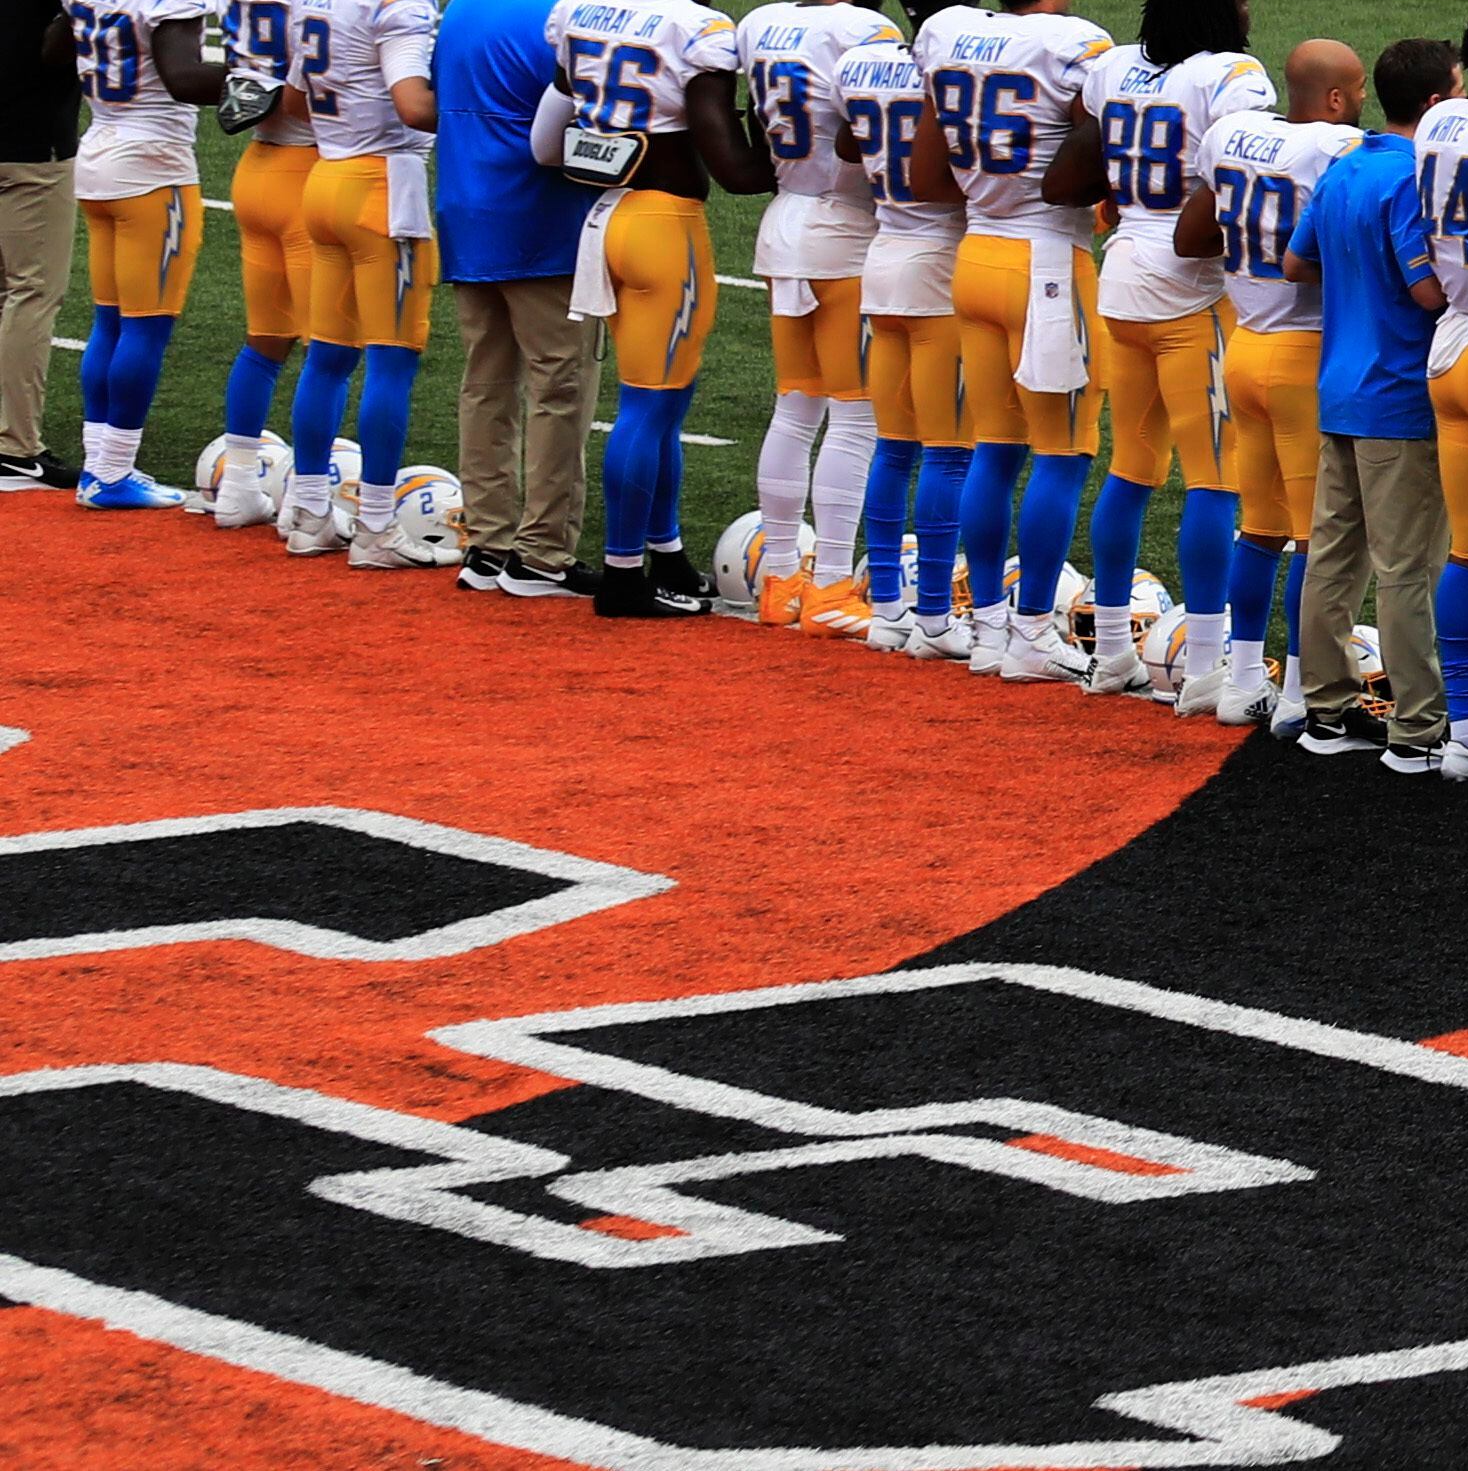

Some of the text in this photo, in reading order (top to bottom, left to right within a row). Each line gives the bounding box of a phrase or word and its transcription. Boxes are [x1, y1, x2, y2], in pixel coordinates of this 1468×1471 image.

[69, 1, 140, 104] 20
[301, 15, 341, 119] 2
[567, 3, 664, 39] MURRAY JR
[755, 25, 808, 52] ALLEN
[951, 34, 1011, 63] HENRY
[567, 34, 662, 135] 56
[750, 58, 815, 162] 13
[841, 60, 915, 89] HAYWARD
[932, 66, 1038, 177] 86
[1101, 97, 1188, 212] 88
[1215, 164, 1299, 282] 30
[419, 491, 435, 515] 2
